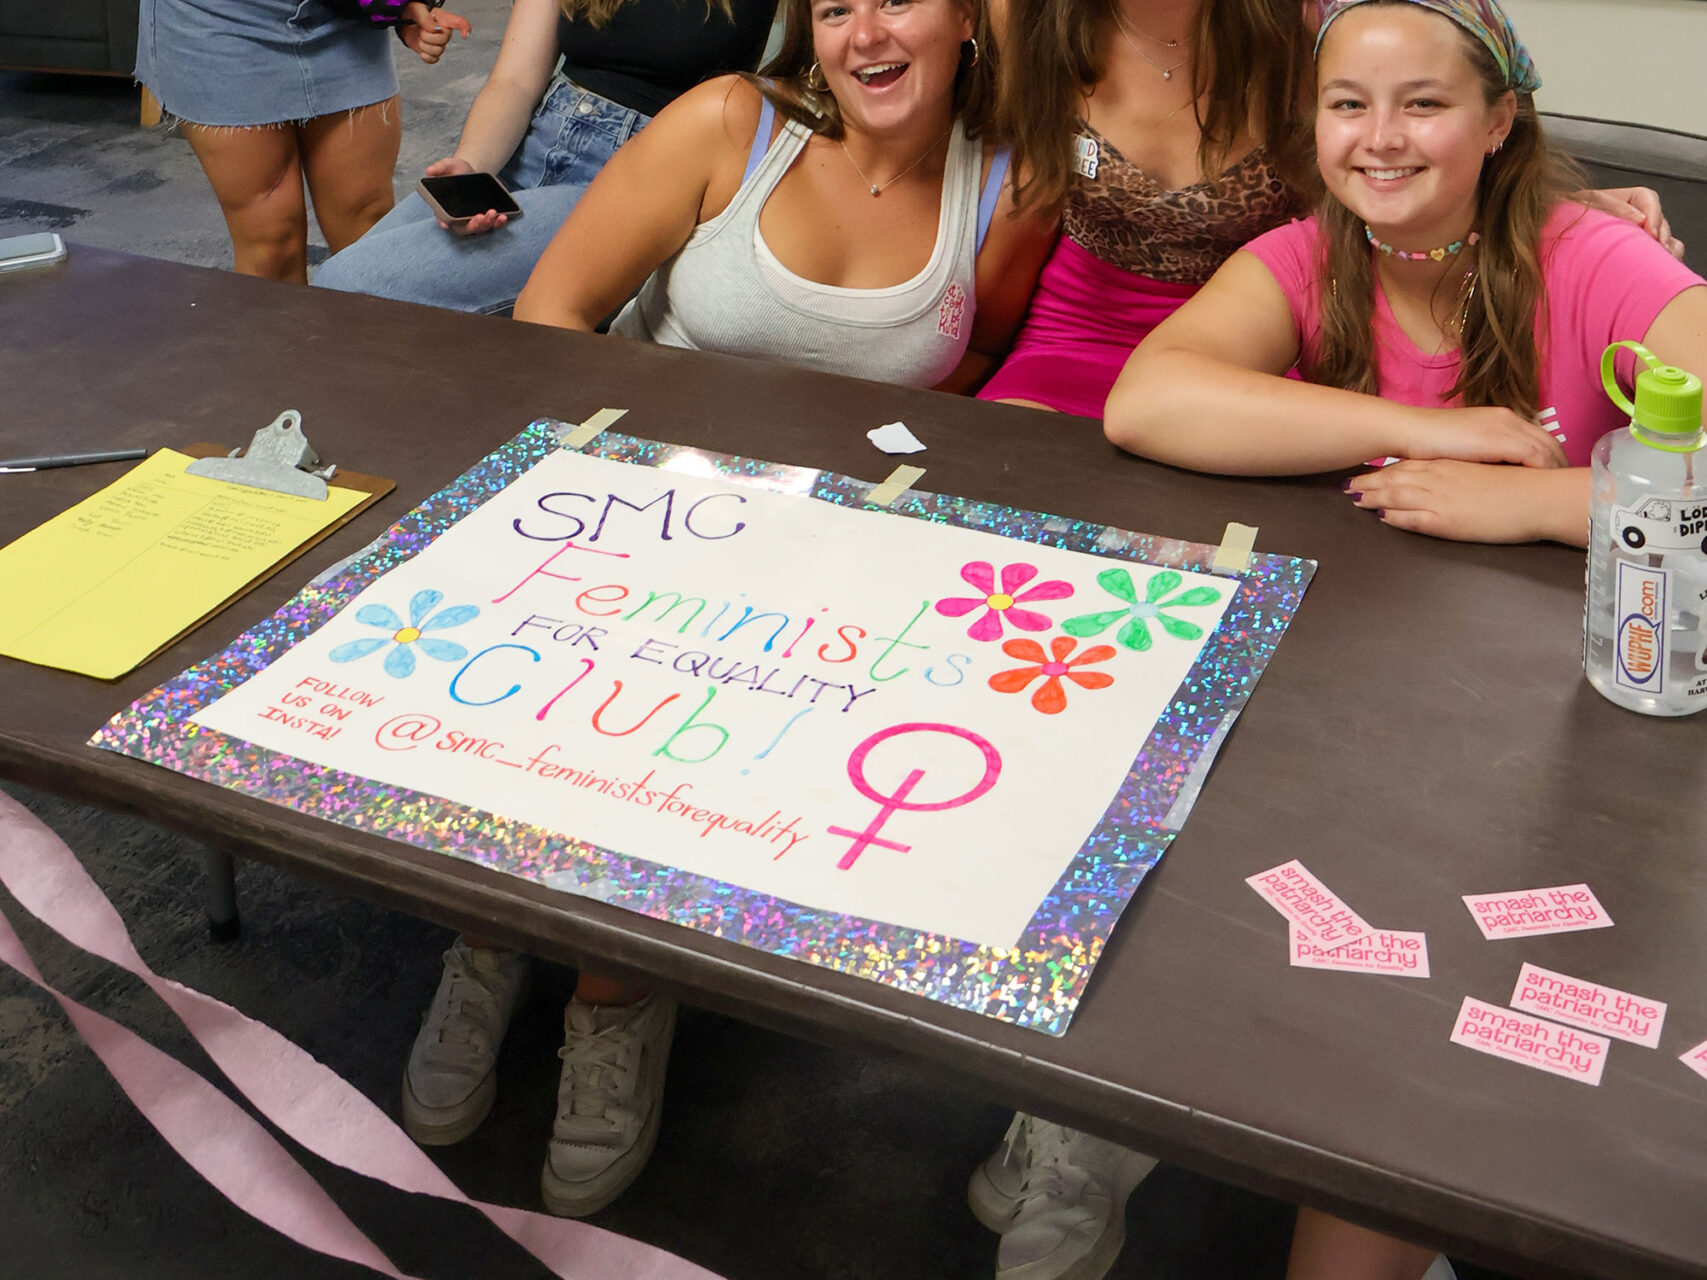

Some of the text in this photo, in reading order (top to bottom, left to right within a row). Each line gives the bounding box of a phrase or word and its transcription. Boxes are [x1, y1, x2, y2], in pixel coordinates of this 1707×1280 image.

[512, 488, 747, 542] SMC
[491, 540, 973, 687] Feminists
[510, 614, 877, 712] FOR EQUALITY
[281, 692, 353, 721] US ON
[295, 676, 386, 708] FOLLOW
[449, 644, 814, 776] Club!
[257, 705, 343, 741] INSTA!
[373, 712, 810, 862] @smc_feministsforequality
[1258, 873, 1343, 942] patriarchy
[1280, 867, 1334, 912] smash
[1330, 910, 1363, 937] the
[1474, 890, 1590, 914] smash the
[1482, 904, 1598, 931] patriarchy
[1379, 933, 1421, 951] the
[1519, 986, 1651, 1037] patriarchy
[1526, 971, 1659, 1020] smash the
[1461, 1020, 1592, 1073] patriarchy
[1467, 1005, 1601, 1056] smash the
